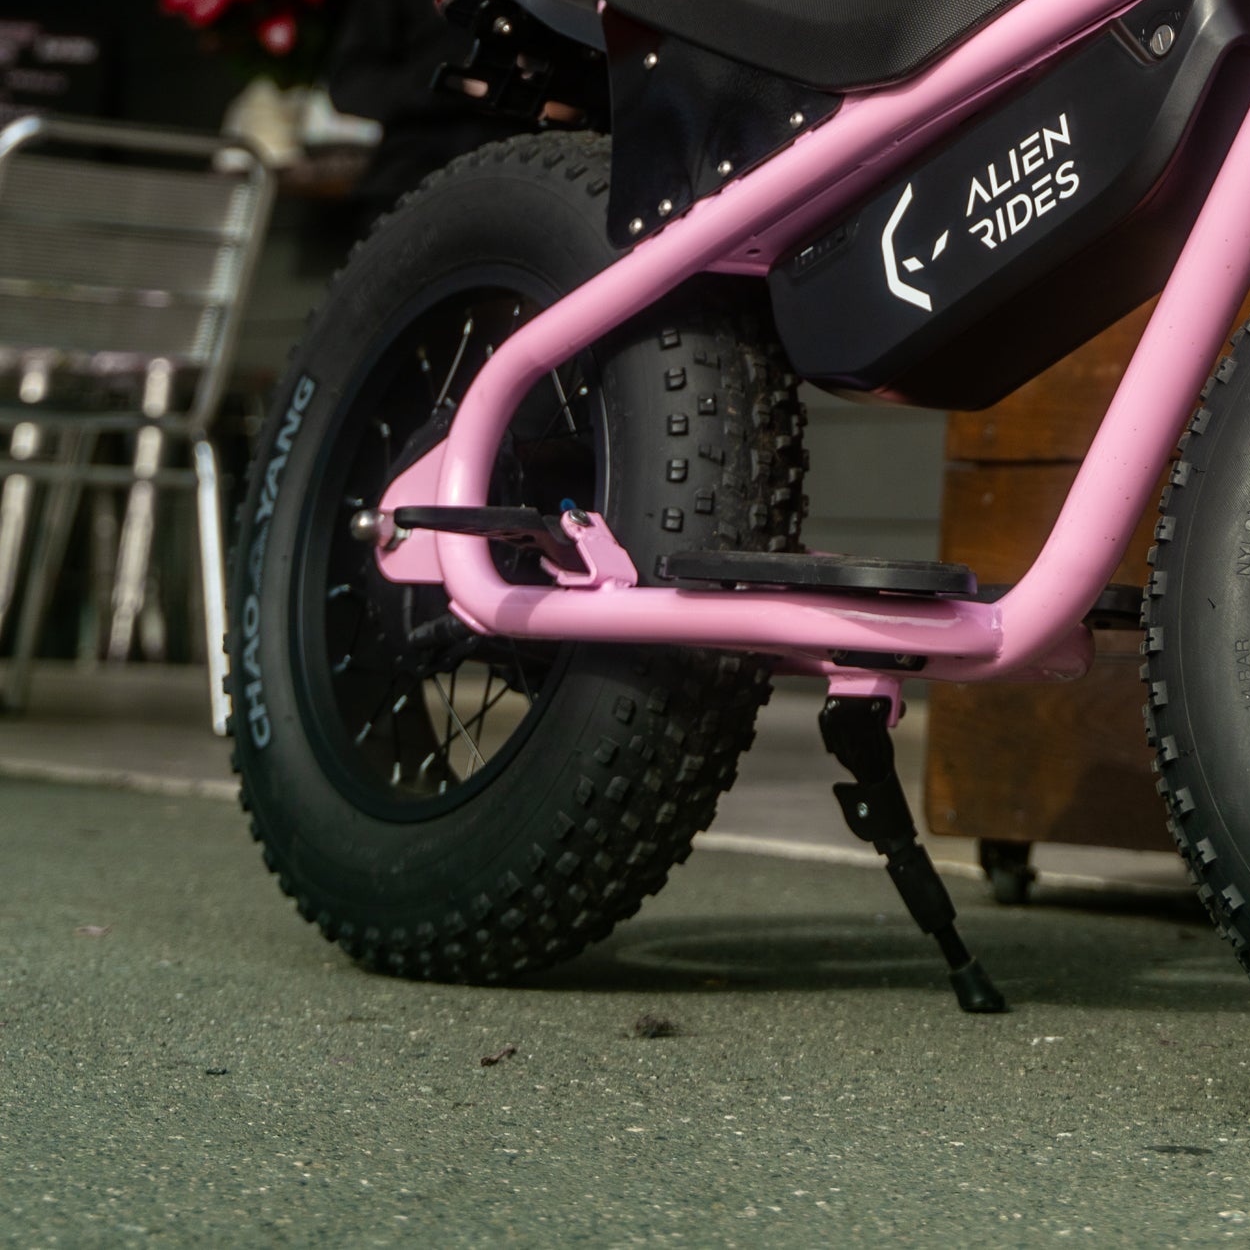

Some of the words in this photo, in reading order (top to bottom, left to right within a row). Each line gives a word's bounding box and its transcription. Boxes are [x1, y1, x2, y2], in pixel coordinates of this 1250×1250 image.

[966, 112, 1071, 217] ALIEN
[968, 160, 1080, 249] RIDES
[255, 375, 317, 525] YANG
[242, 592, 272, 749] CHAO
